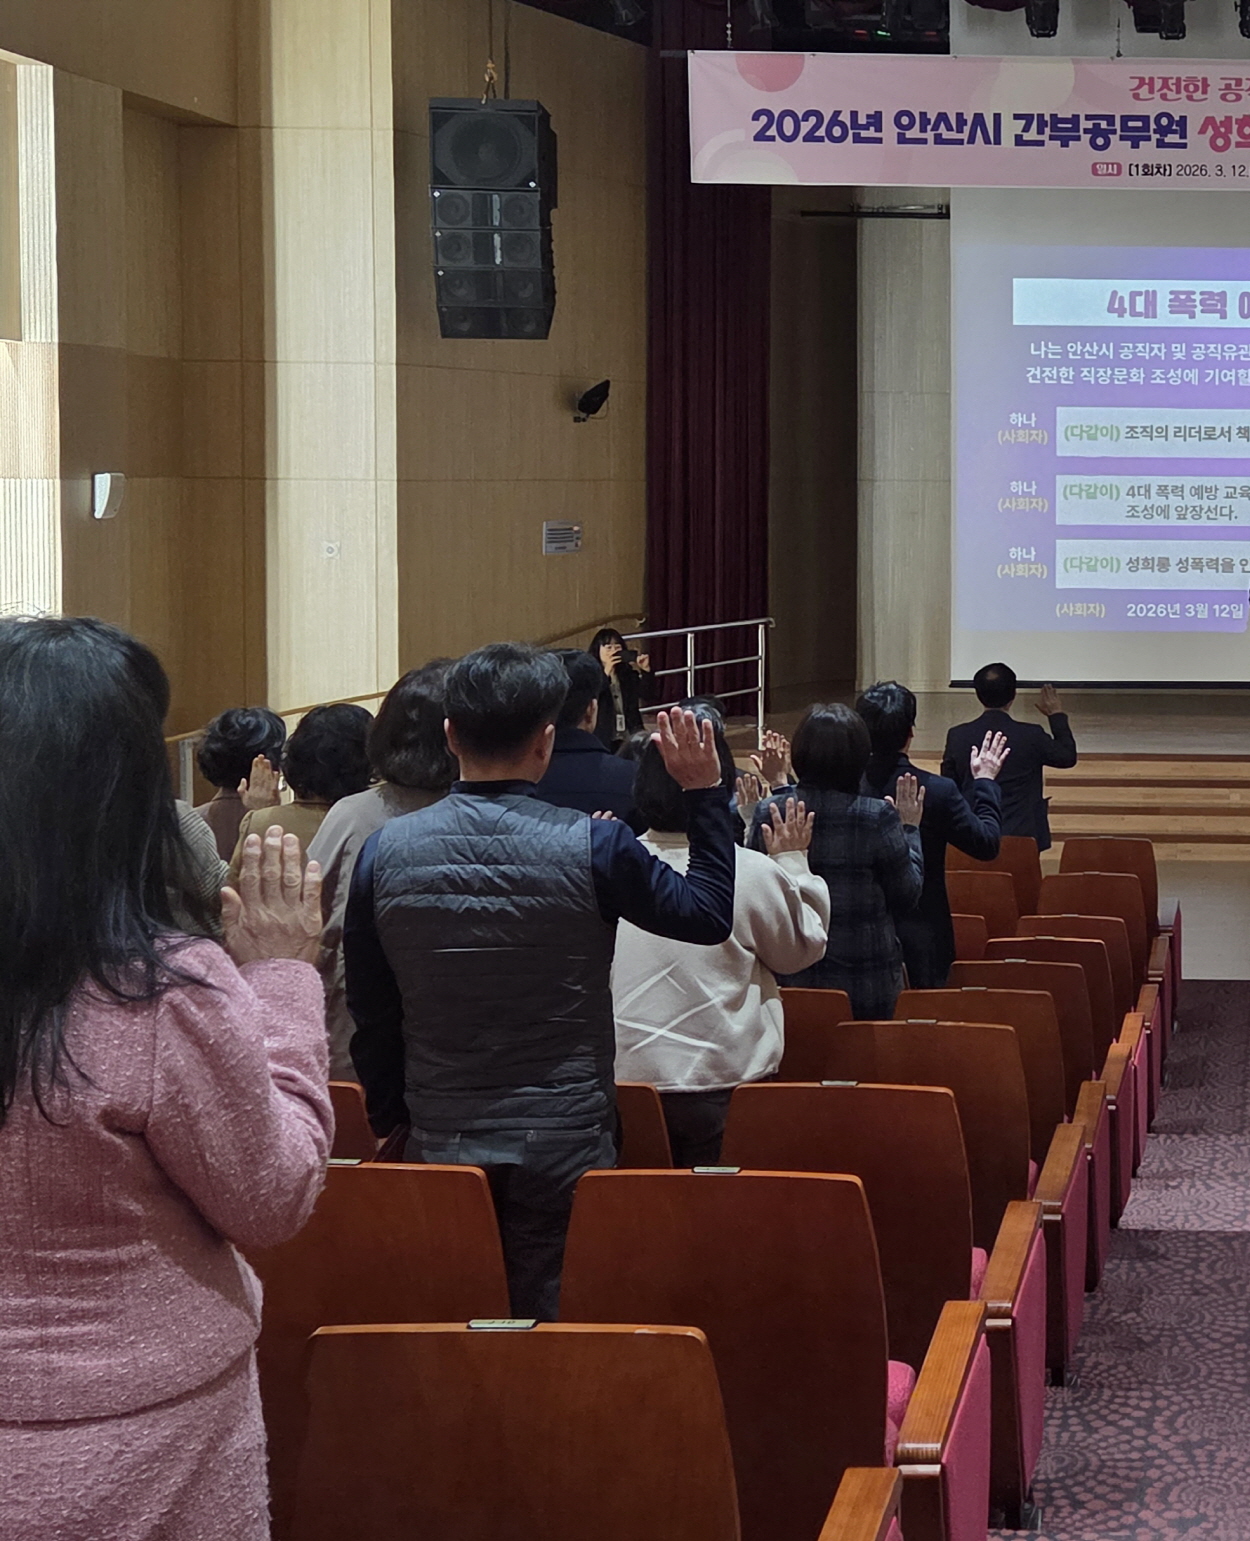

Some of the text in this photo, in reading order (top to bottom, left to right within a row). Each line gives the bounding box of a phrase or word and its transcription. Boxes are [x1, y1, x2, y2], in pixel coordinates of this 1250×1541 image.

[1129, 76, 1210, 101] 건전한
[751, 109, 883, 143] 2026년
[893, 110, 1001, 145] 안산시
[1012, 112, 1188, 150] 간부공무원
[1095, 163, 1118, 175] 일시
[1128, 163, 1172, 176] [1회차]
[1176, 164, 1211, 177] 2026.
[1215, 164, 1226, 177] 3.
[1106, 289, 1157, 318] 4대
[1167, 290, 1227, 319] 폭력
[1030, 341, 1062, 358] 나는
[1066, 341, 1113, 358] 안산시
[1118, 342, 1166, 359] 공직자
[1171, 342, 1186, 359] 및
[1026, 366, 1075, 384] 건전한
[1080, 367, 1145, 384] 직장문화
[1150, 368, 1198, 385] 조성에
[1009, 412, 1036, 427] 하나
[998, 428, 1048, 443] (사회자)
[1064, 424, 1120, 441] (다같이)
[1124, 424, 1168, 441] 조직의
[1173, 425, 1231, 442] 리더로서
[1010, 480, 1037, 495] 하나
[1062, 483, 1120, 500] (다같이)
[1125, 483, 1151, 499] 4대
[1155, 484, 1184, 500] 폭력
[1189, 484, 1219, 500] 예방
[998, 496, 1048, 511] (사회자)
[1124, 504, 1238, 520] 조성에 앞장선다.
[1008, 546, 1036, 561] 하나
[997, 562, 1047, 577] (사회자)
[1064, 556, 1120, 572] (다같이)
[1125, 556, 1171, 572] 성희롱
[1175, 556, 1235, 573] 성폭력을
[1055, 602, 1106, 617] (사회자)
[1126, 603, 1180, 617] 2026년
[1184, 603, 1208, 618] 3월
[1212, 603, 1243, 618] 12일
